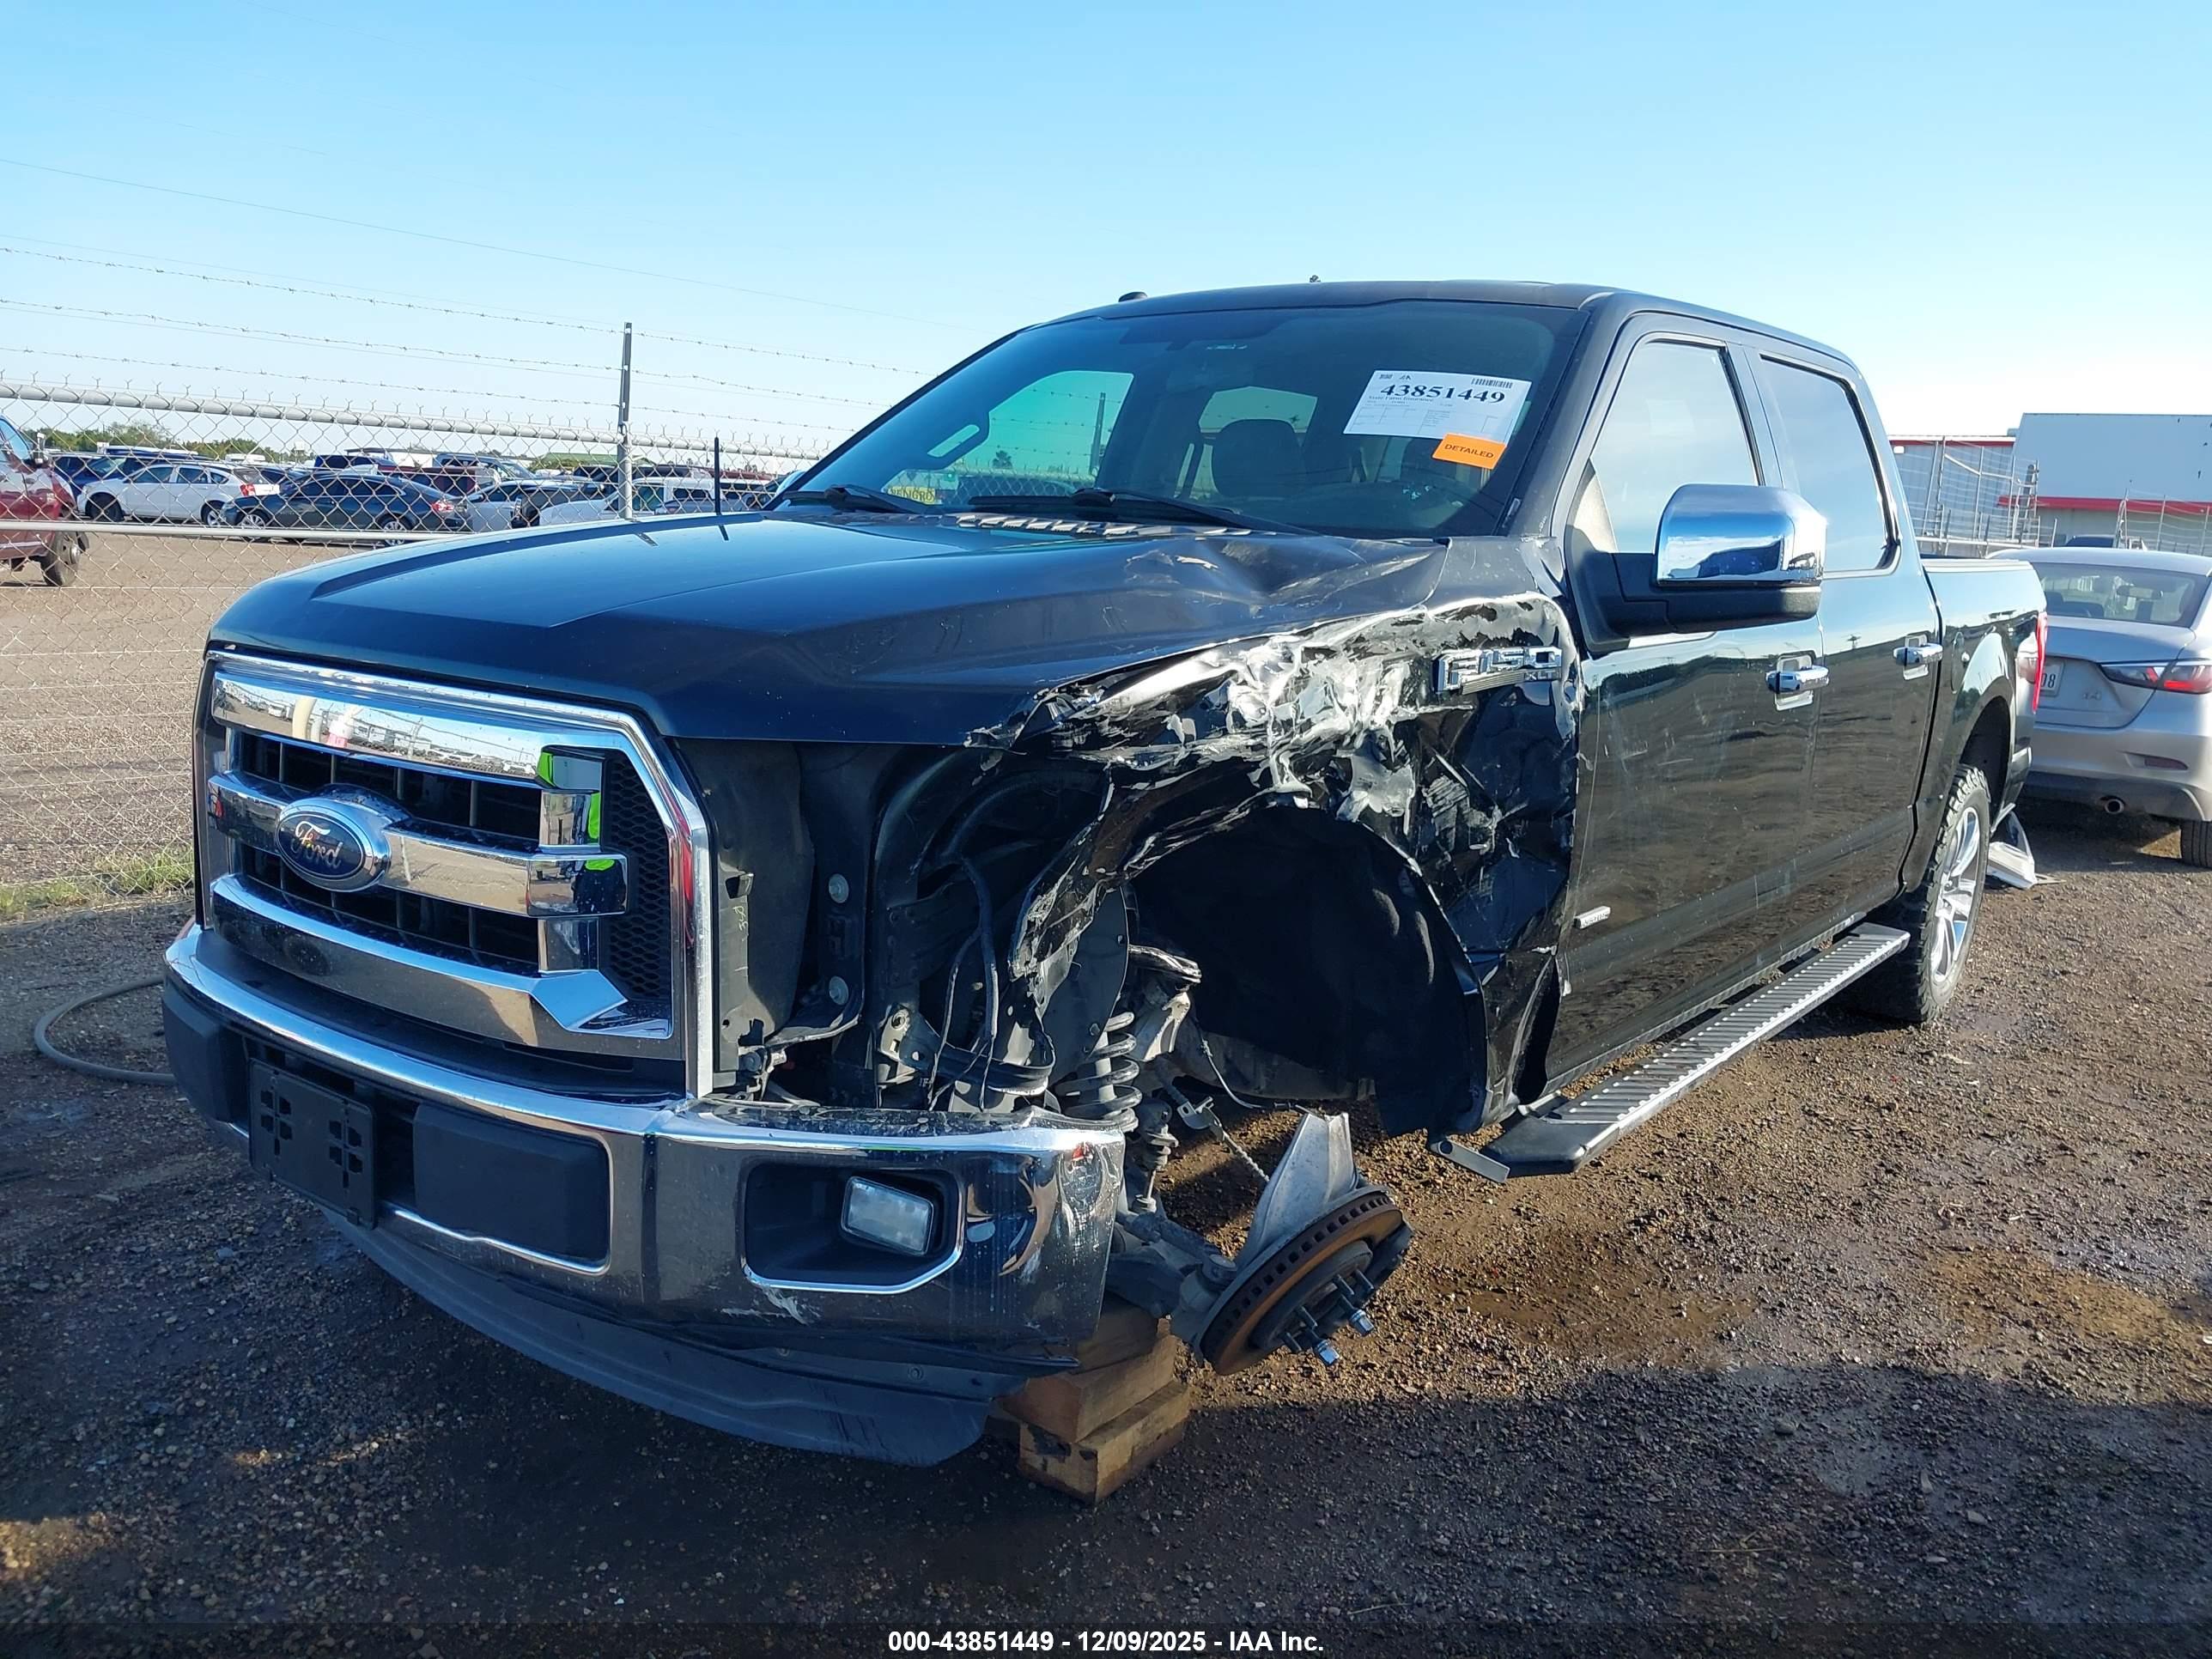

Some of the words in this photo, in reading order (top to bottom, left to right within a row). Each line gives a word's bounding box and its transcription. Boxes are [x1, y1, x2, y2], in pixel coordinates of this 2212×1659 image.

[1380, 384, 1505, 404] 43851449
[1443, 443, 1494, 459] DETAILED
[1524, 671, 1557, 681] XLT
[290, 820, 343, 869] Ford
